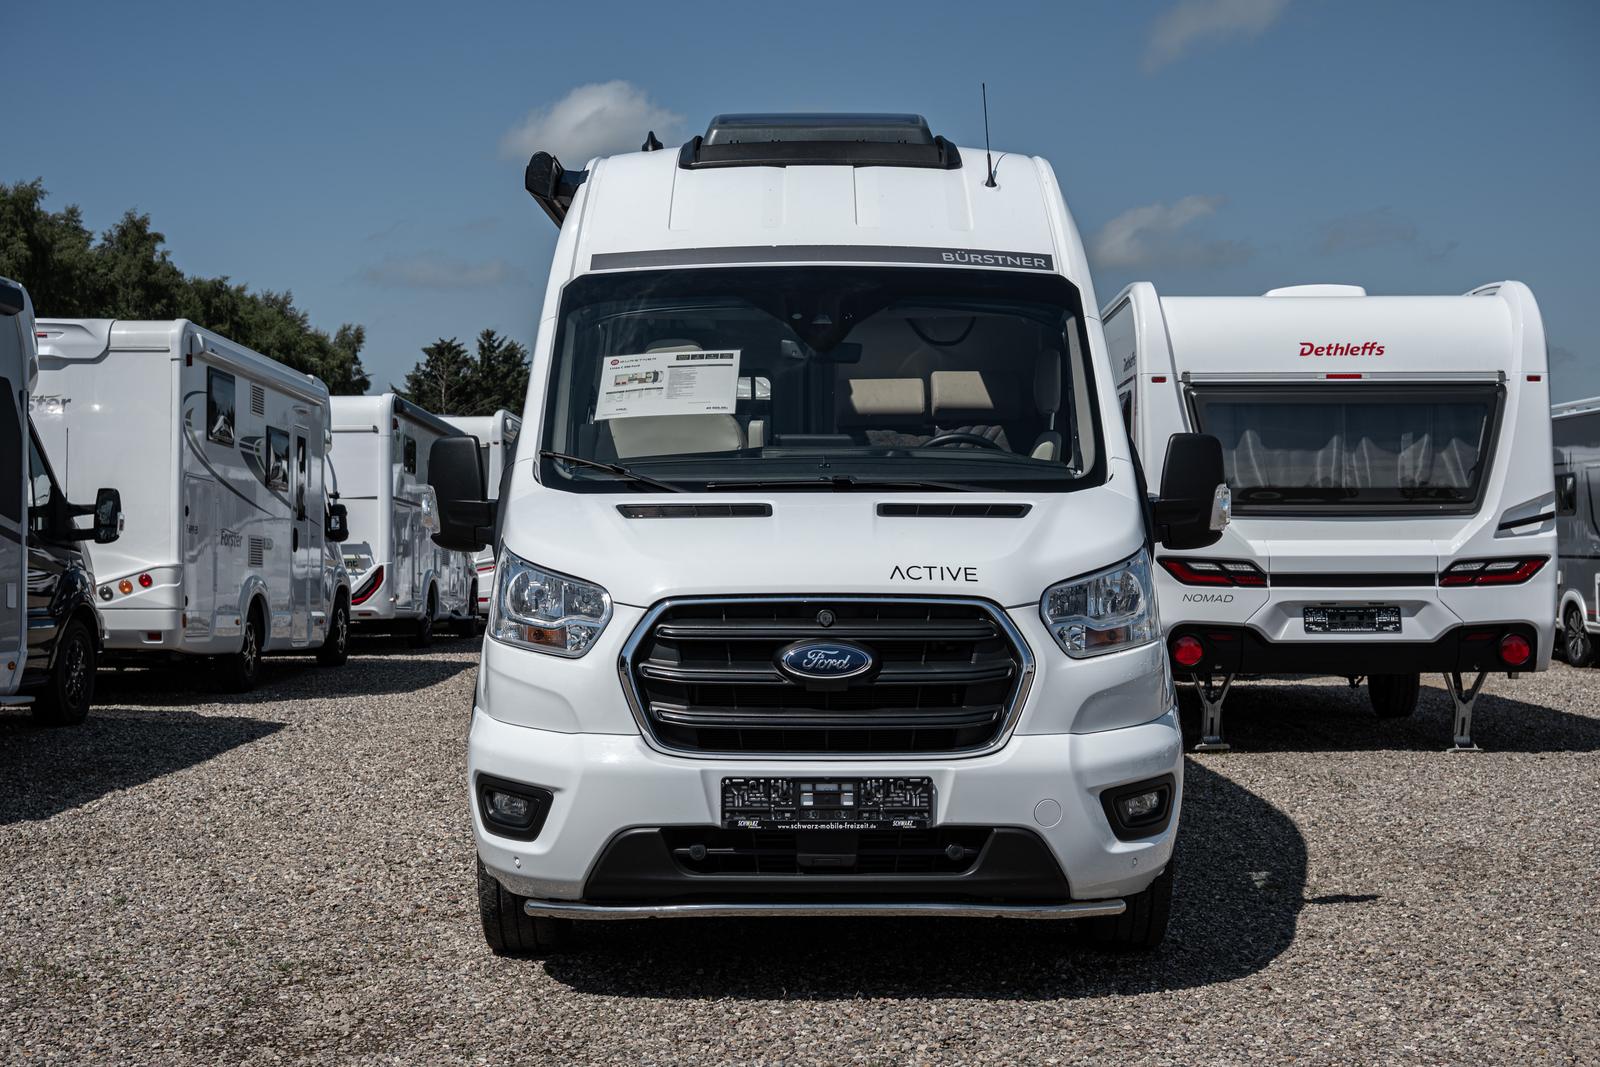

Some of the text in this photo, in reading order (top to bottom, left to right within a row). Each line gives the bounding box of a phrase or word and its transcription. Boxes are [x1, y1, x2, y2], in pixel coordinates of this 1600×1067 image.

[942, 251, 1047, 267] BÜRSTNER
[1299, 341, 1385, 356] Dethleffs
[889, 565, 979, 582] ACTIVE
[1182, 593, 1234, 603] NOMAD
[802, 649, 851, 670] Ford
[777, 822, 877, 830] www.schwarz-mobile-freizeit.de
